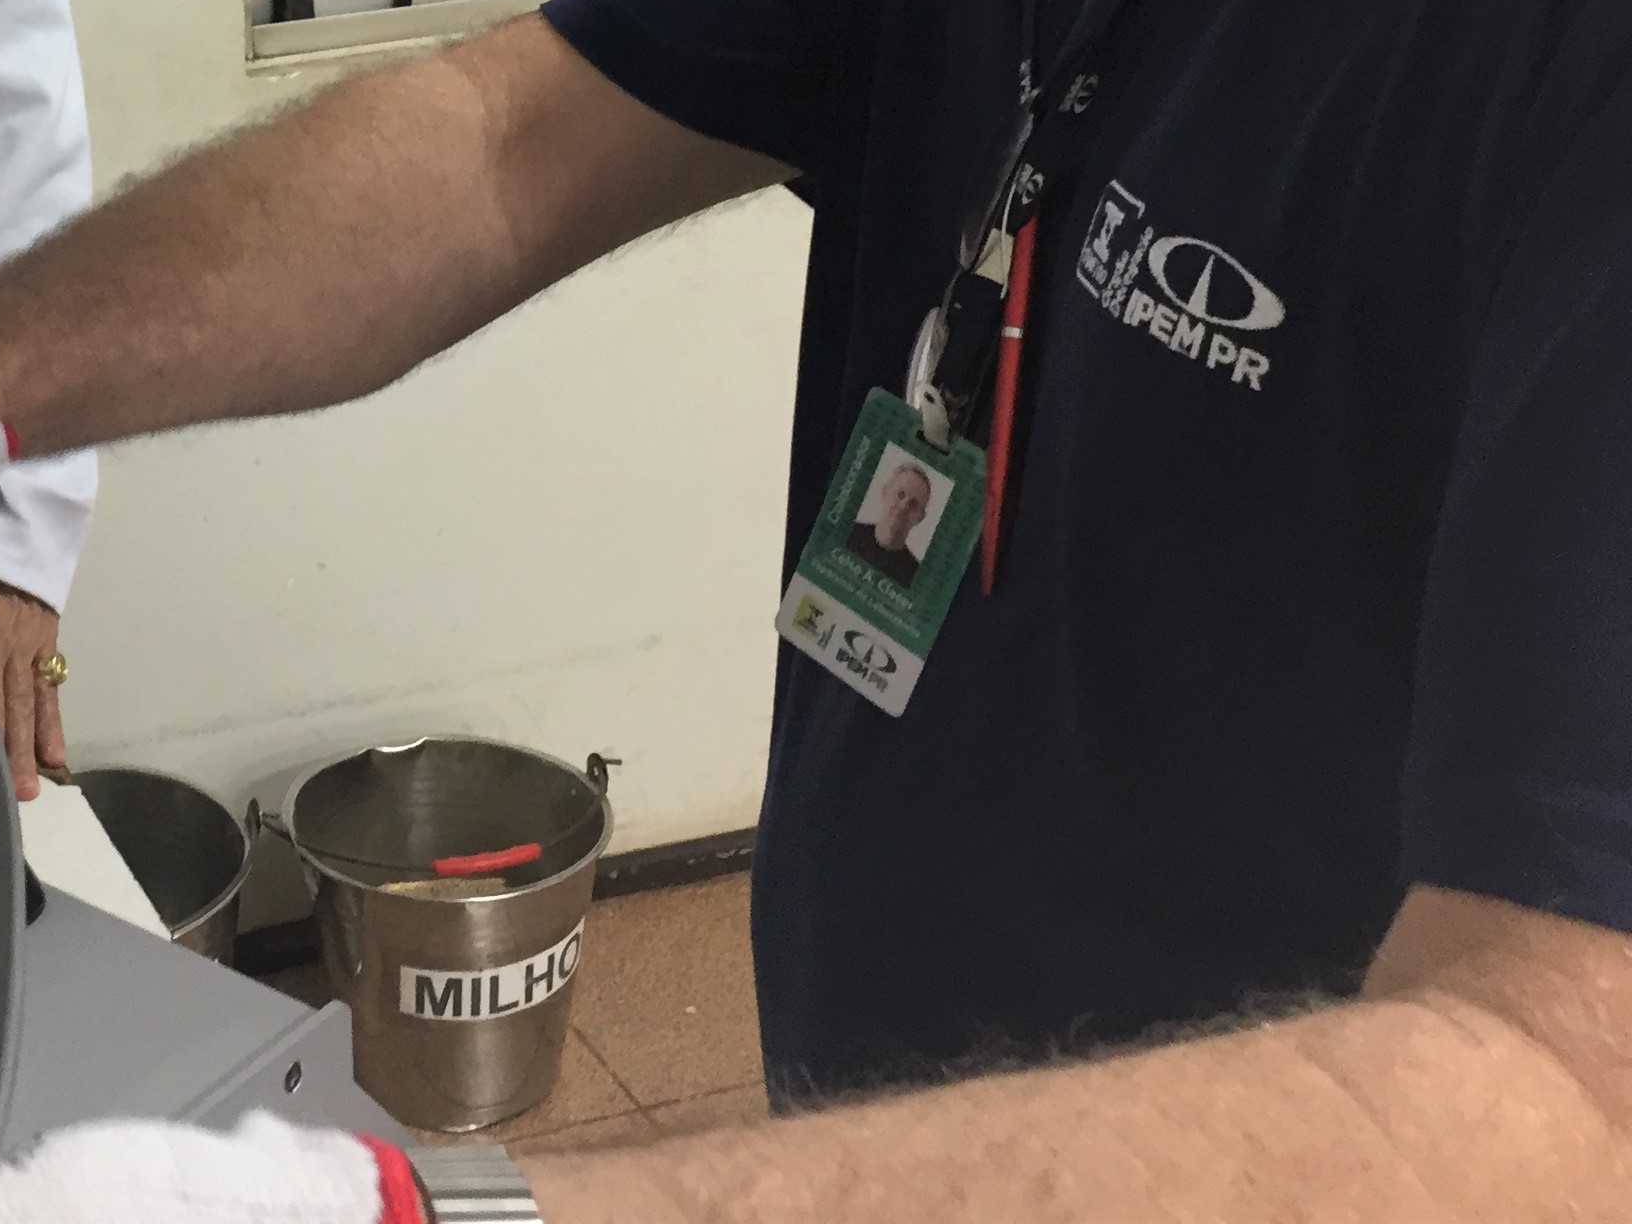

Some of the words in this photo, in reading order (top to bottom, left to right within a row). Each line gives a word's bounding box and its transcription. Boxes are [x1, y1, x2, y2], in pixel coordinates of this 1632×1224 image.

[1123, 288, 1206, 359] IPEM
[1206, 333, 1270, 391] PR
[414, 931, 581, 1017] MILHO
